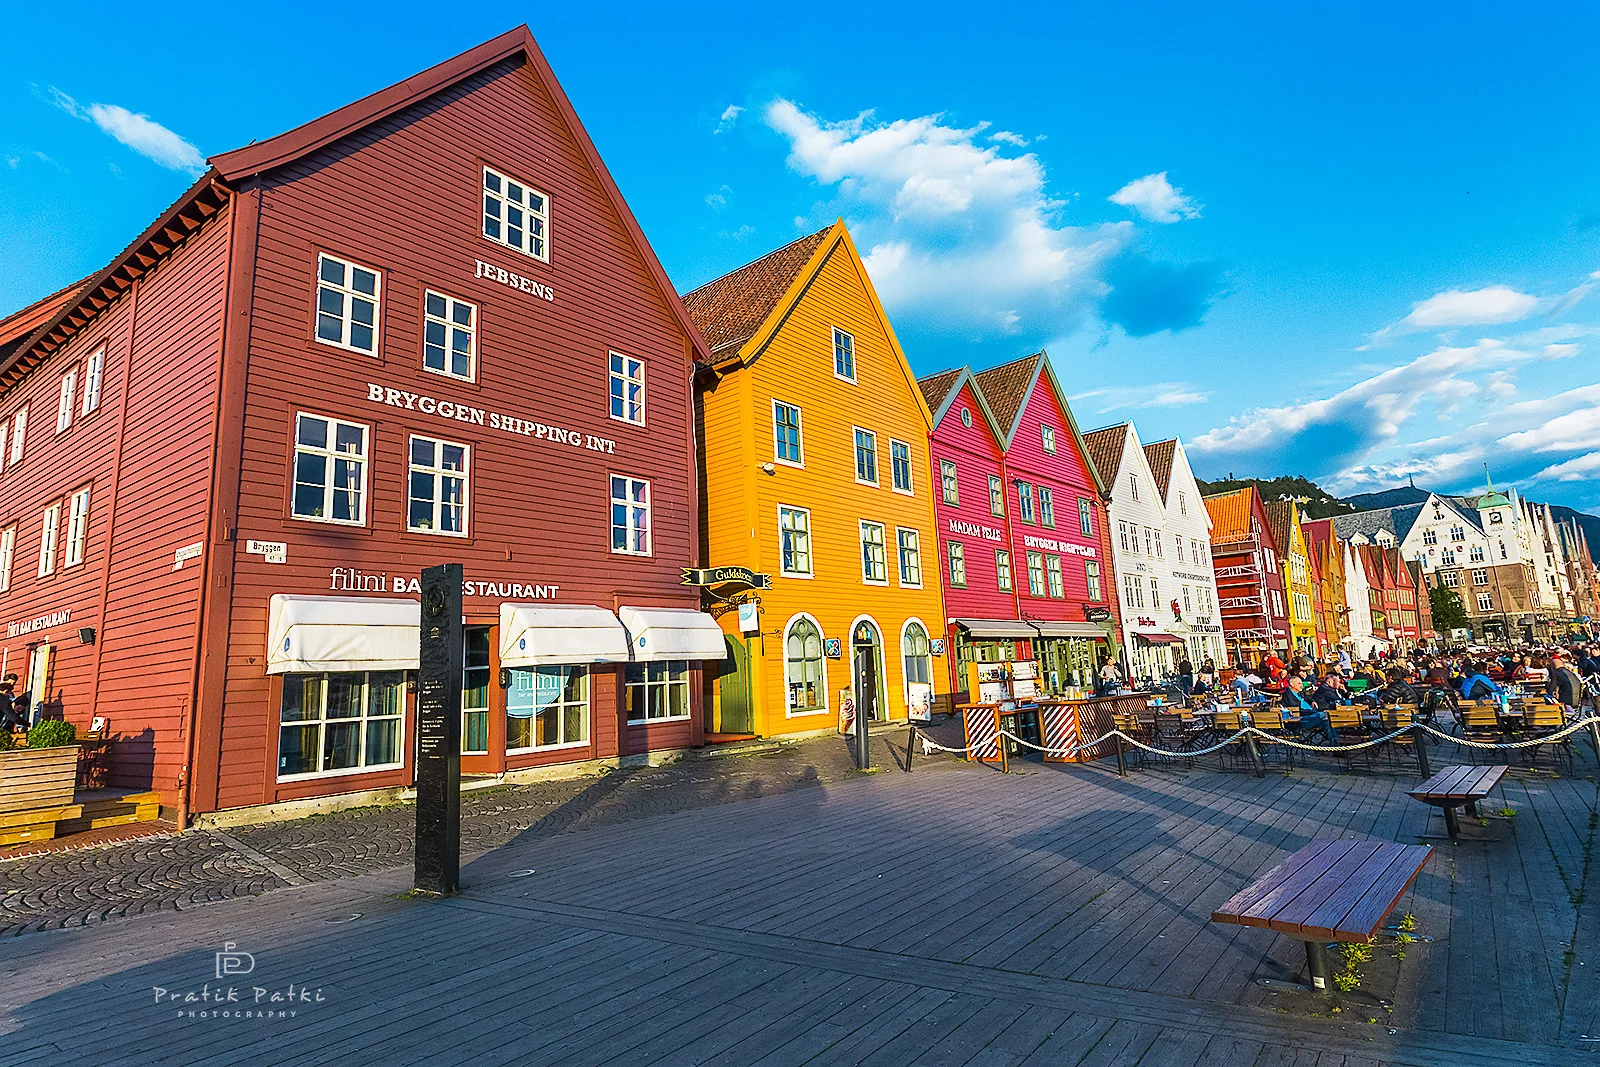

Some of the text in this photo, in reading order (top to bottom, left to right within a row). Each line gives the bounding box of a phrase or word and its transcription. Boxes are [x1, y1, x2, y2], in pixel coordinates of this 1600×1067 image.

[474, 259, 554, 302] JEBSENS
[367, 383, 616, 455] BRYGGEN SHIPPING INT
[948, 519, 1002, 542] MADAM FELLE
[253, 542, 281, 553] Bryggen
[1023, 535, 1059, 552] BRYGGEN
[329, 567, 388, 593] filini
[393, 576, 422, 594] BA
[32, 608, 72, 631] RESTAURANT
